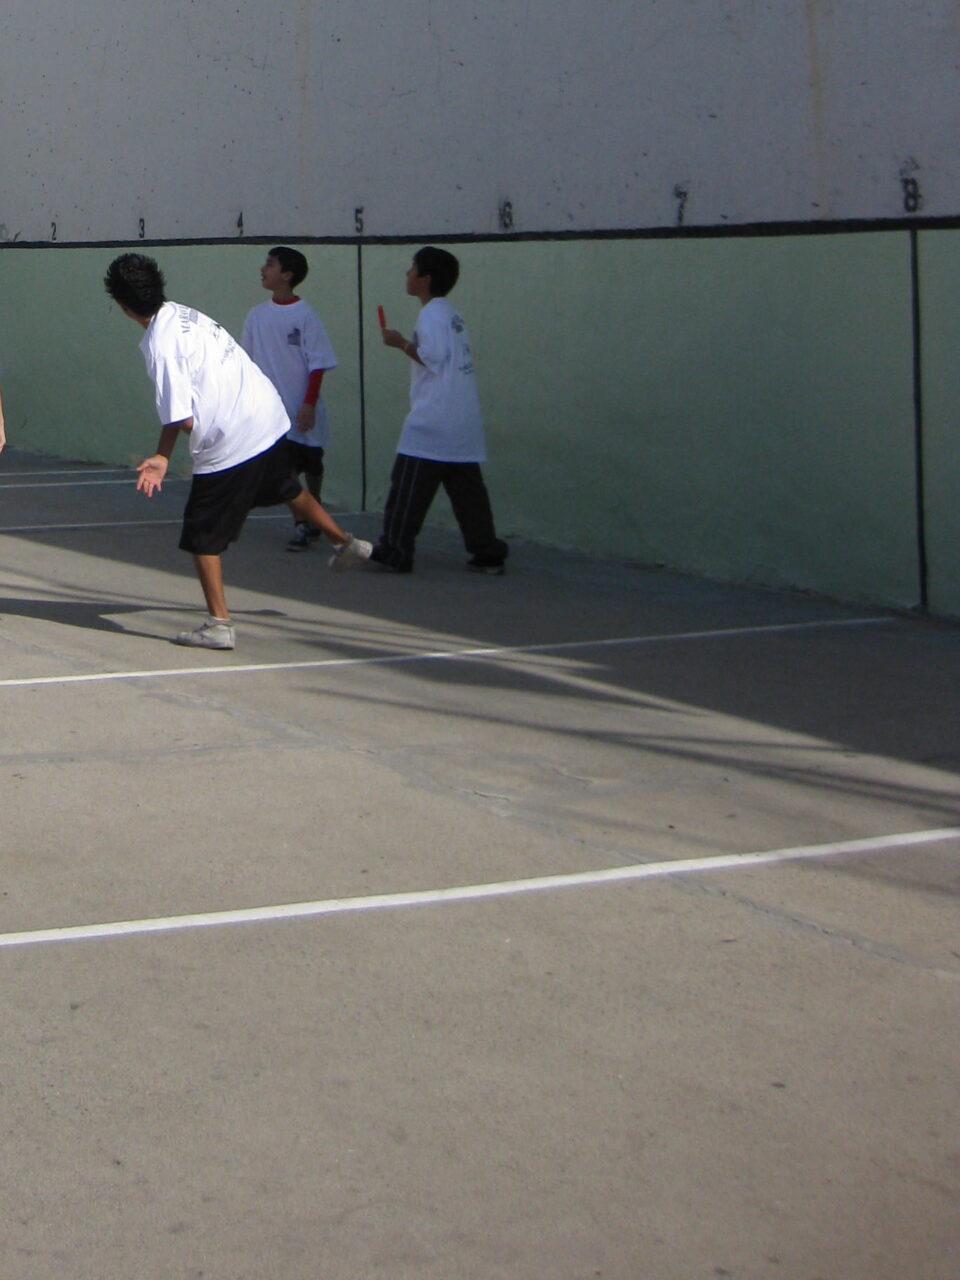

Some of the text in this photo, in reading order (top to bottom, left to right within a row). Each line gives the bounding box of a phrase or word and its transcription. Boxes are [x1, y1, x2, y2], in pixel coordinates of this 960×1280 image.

[50, 221, 57, 241] 2
[138, 217, 146, 239] 3
[236, 211, 244, 237] 4
[354, 206, 364, 233] 5
